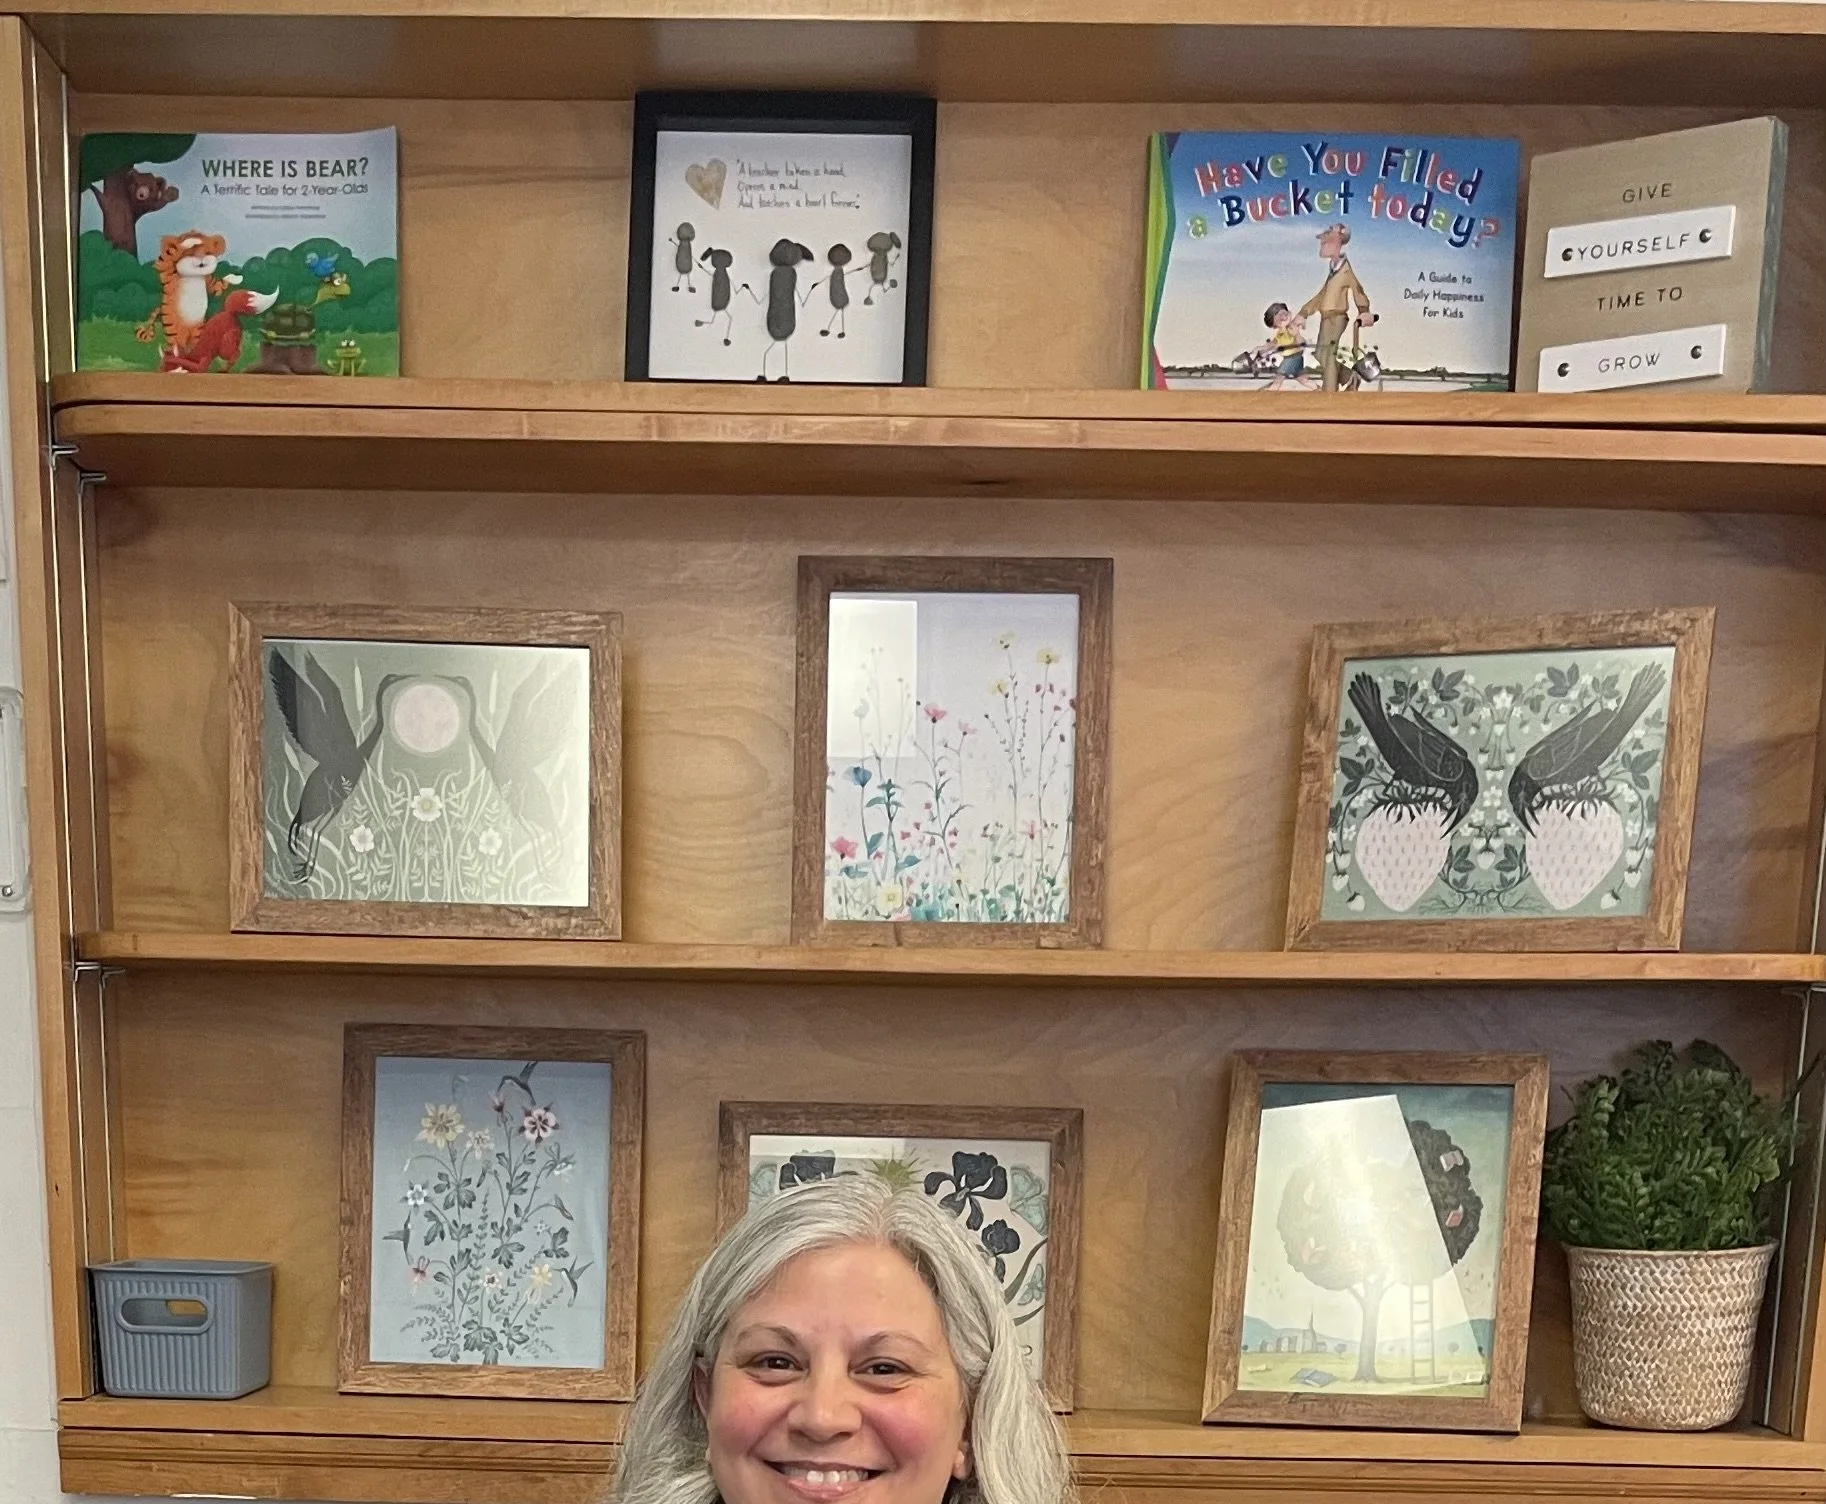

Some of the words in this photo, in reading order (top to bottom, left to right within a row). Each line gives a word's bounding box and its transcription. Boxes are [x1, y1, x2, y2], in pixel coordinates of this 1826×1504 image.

[202, 159, 274, 178] WHERE
[281, 159, 298, 178] IS
[306, 156, 369, 178] BEAR?
[1195, 153, 1288, 198] Have
[1302, 140, 1366, 176] You
[1379, 146, 1483, 206] Filled
[201, 184, 210, 194] A
[214, 183, 251, 195] Terrific
[255, 184, 279, 195] Tale
[283, 184, 298, 195] for
[1622, 182, 1673, 204] GIVE
[1188, 214, 1208, 240] a
[1218, 179, 1354, 228] Bucket
[1368, 182, 1501, 248] today?
[1577, 232, 1690, 260] YOURSELF
[1418, 271, 1426, 282] A
[1429, 271, 1458, 283] Guide
[1462, 274, 1472, 284] to
[1404, 287, 1430, 302] Daily
[1433, 289, 1484, 302] Happiness
[1597, 291, 1644, 312] TIME
[1657, 286, 1683, 302] TO
[1423, 306, 1440, 317] For
[1443, 307, 1464, 319] Kids
[1598, 352, 1661, 374] GROW
